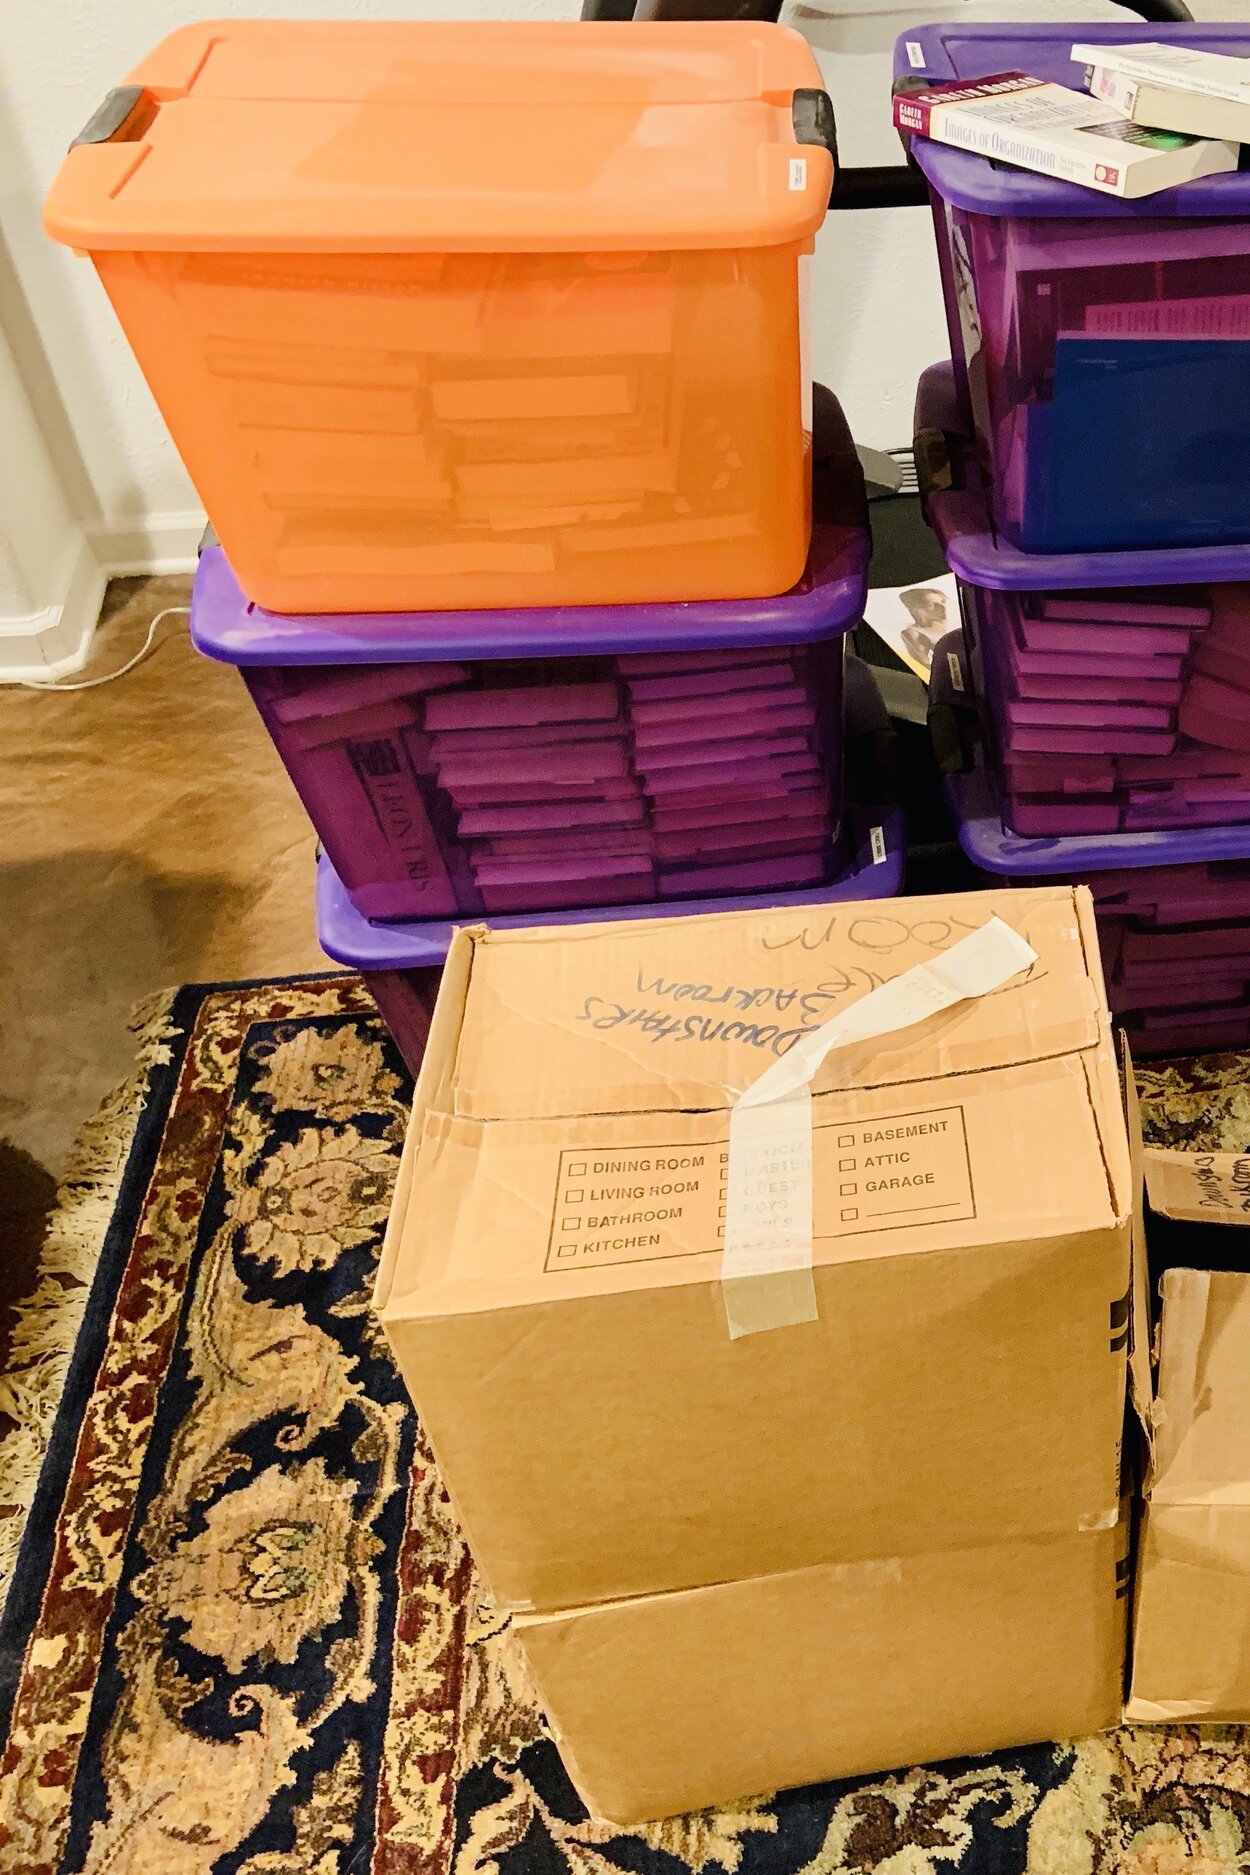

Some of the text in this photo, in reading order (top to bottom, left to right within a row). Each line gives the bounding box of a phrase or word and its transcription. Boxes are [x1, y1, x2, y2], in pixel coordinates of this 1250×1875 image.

[976, 76, 1046, 95] MORGAN
[899, 103, 922, 120] GARETH
[899, 113, 923, 130] MORGAN
[863, 1120, 949, 1144] BASEMENT
[593, 1156, 705, 1174] DINING ROOM
[864, 1151, 911, 1168] ATTIC
[590, 1180, 700, 1202] LIVING ROOM
[865, 1172, 935, 1192] GARAGE
[587, 1207, 683, 1228] BATHROOM
[583, 1234, 661, 1254] KITCHEN
